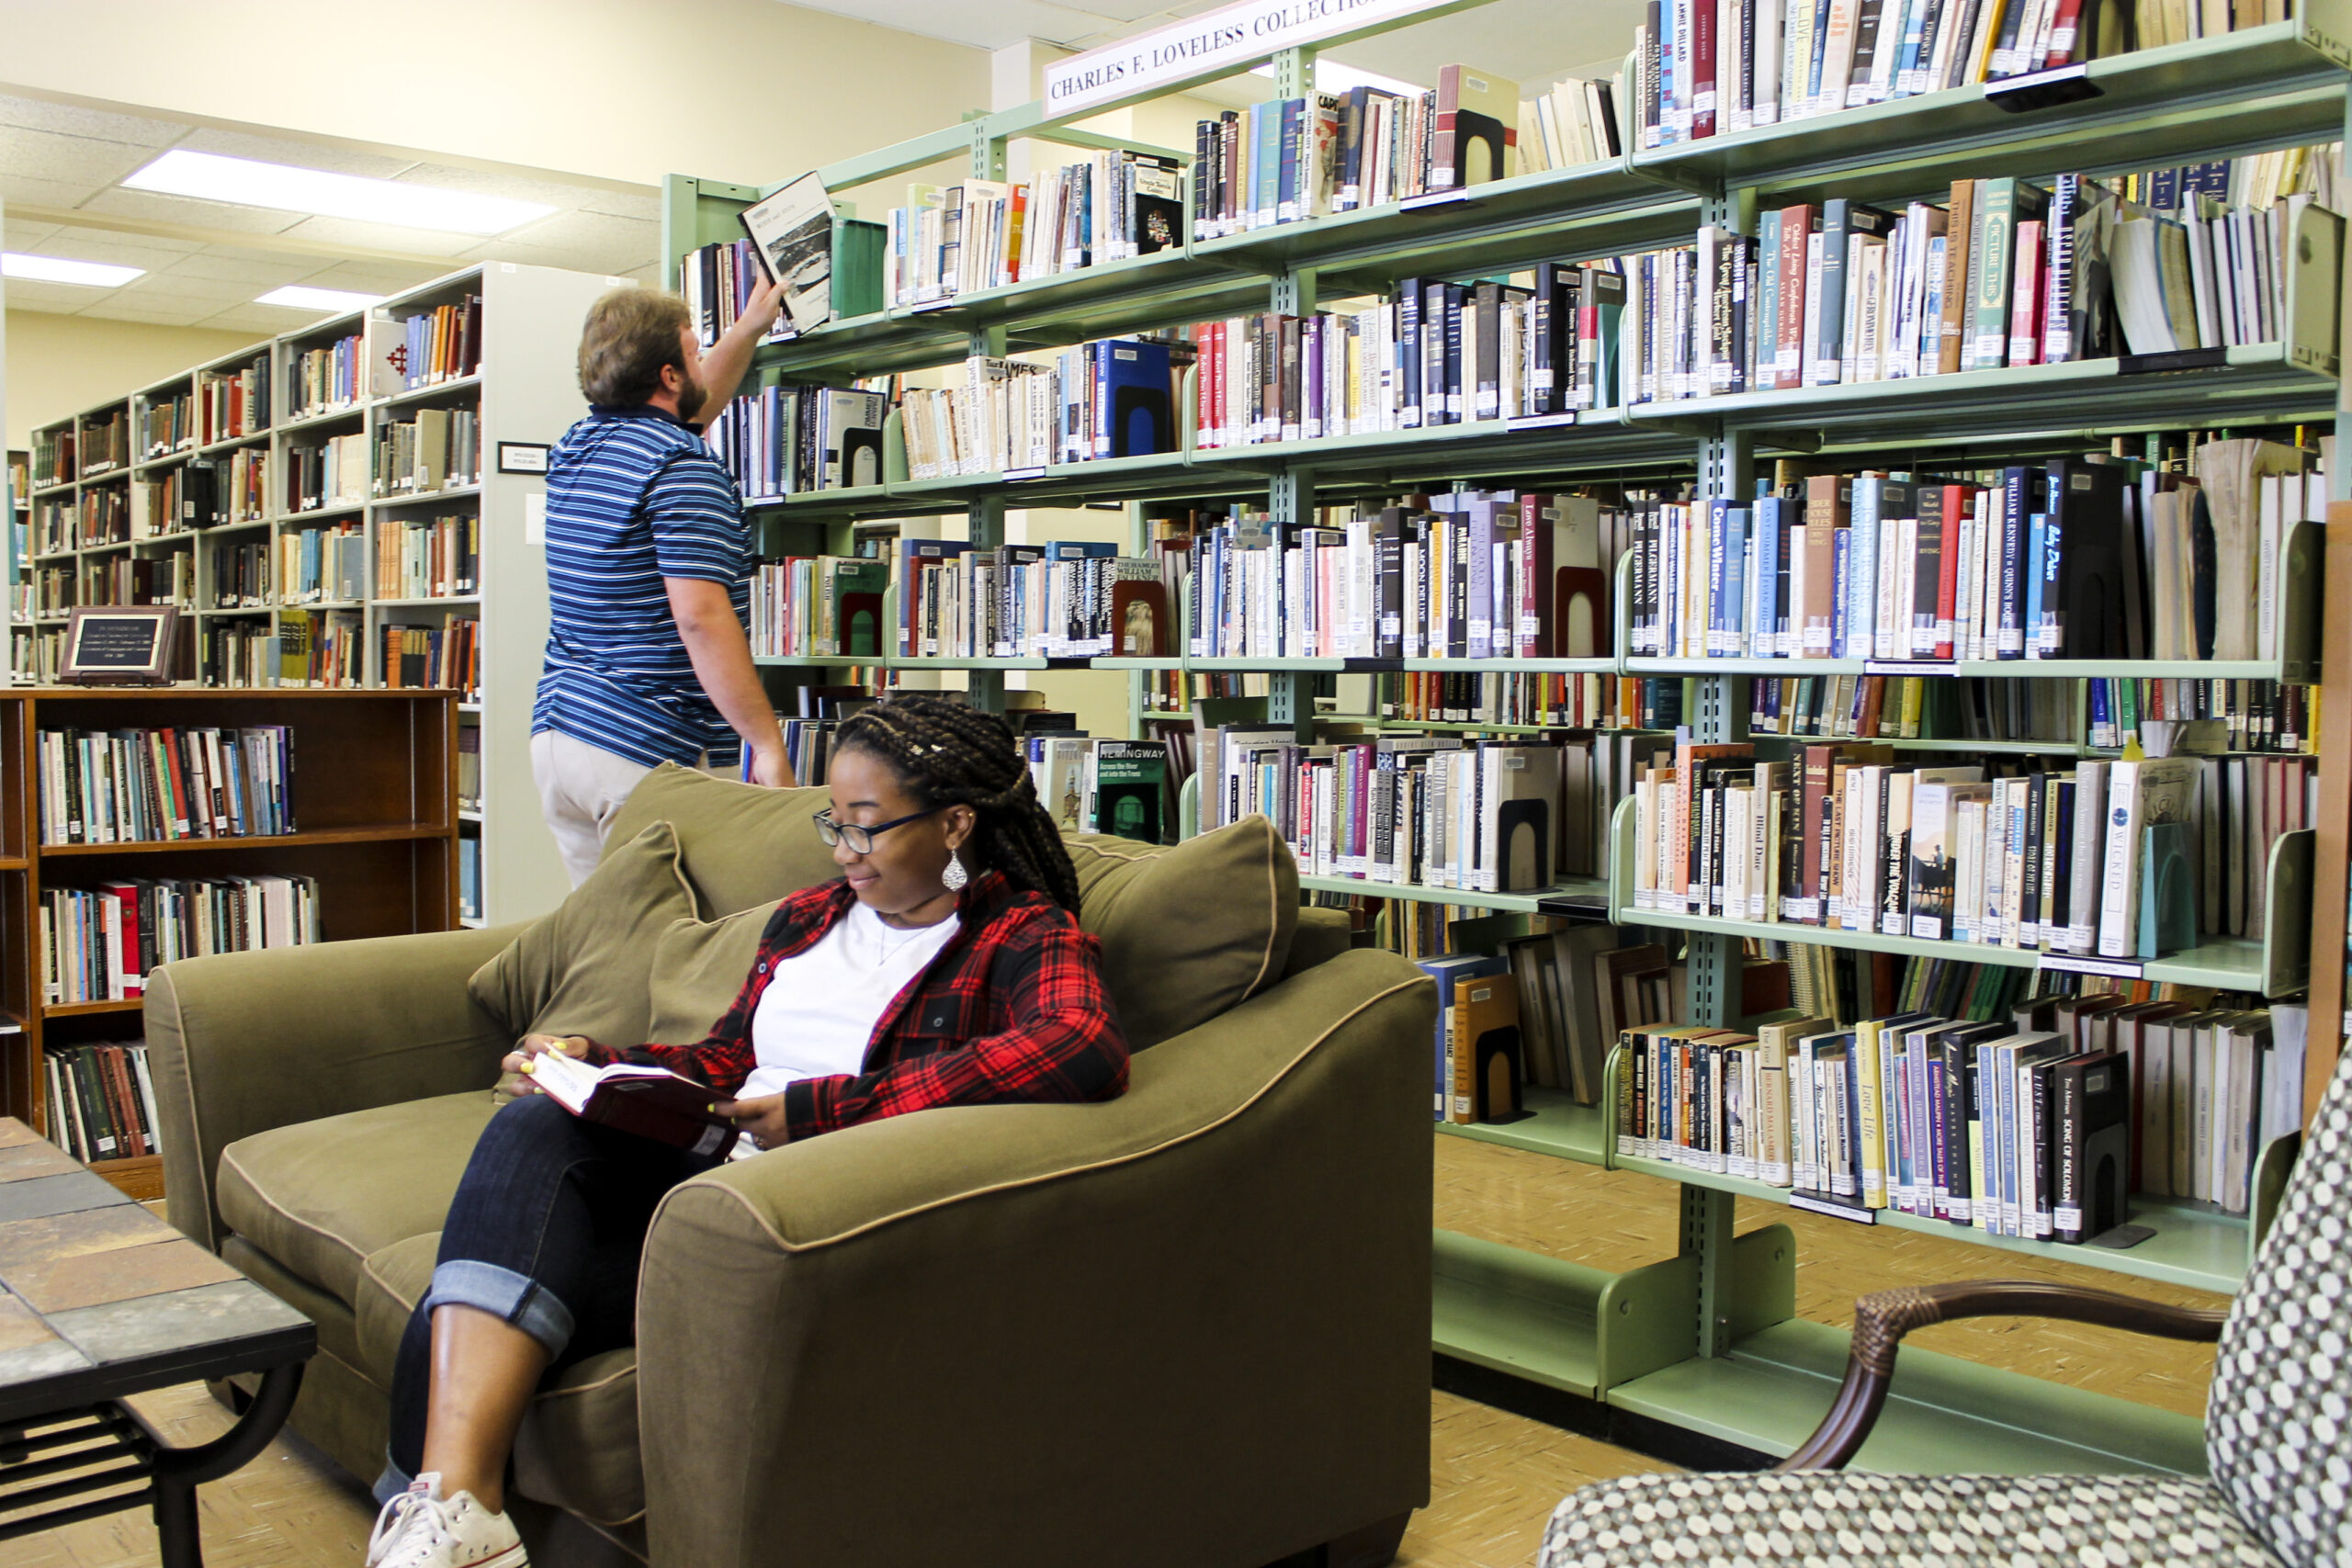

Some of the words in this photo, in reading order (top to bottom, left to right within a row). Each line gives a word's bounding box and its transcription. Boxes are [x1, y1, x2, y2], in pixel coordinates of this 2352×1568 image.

[1678, 3, 1687, 26] ANNIE
[1797, 6, 1812, 42] LOVE
[1678, 29, 1687, 62] DILLARD
[1051, 62, 1124, 100] CHARLES
[1133, 55, 1145, 74] F.
[1153, 24, 1244, 68] LOVELESS
[1951, 200, 1961, 227] THIS
[1782, 226, 1791, 243] Tells
[1792, 223, 1801, 249] Oldest
[1951, 231, 1959, 243] IS
[1972, 214, 1981, 246] ROBERT
[1722, 243, 1733, 261] The
[1782, 245, 1791, 258] All
[1987, 223, 2001, 269] PICTURE
[1766, 251, 1776, 269] The
[1788, 253, 1800, 276] Living
[1719, 262, 1733, 287] Great
[1765, 270, 1775, 287] Old
[1945, 247, 1957, 309] TEACHING
[1987, 272, 1999, 297] THIS
[1713, 288, 1722, 321] Herbert
[1788, 278, 1799, 324] Confederate
[1965, 296, 1975, 330] POETRY
[1567, 308, 1576, 330] Native
[1713, 323, 1722, 341] Gold
[1567, 349, 1576, 374] Richard
[2007, 477, 2018, 515] WILLIAM
[1525, 504, 1534, 526] Love
[1712, 507, 1724, 546] Come
[1851, 497, 1860, 531] PRAYER
[1861, 506, 1874, 551] JOHN
[2006, 518, 2016, 558] KENNEDY
[2044, 525, 2062, 547] Baby
[1456, 527, 1467, 565] PARADISE
[1523, 527, 1534, 560] Always
[1634, 540, 1643, 604] PILGERMANN
[1648, 539, 1658, 604] PILGERMANN
[1711, 546, 1724, 592] Winter
[1850, 556, 1860, 589] OWEN
[1990, 548, 1999, 604] IRONWEED
[2045, 548, 2060, 581] Driver
[1762, 580, 1770, 603] EVAN
[1860, 557, 1873, 608] IRVING
[2005, 568, 2015, 600] QUINN'S
[2003, 602, 2012, 624] BOOK
[1116, 762, 1125, 771] the
[1127, 770, 1141, 778] Trees
[1434, 755, 1446, 796] SPARTINA
[1792, 753, 1802, 786] NEXT
[1792, 788, 1801, 805] OF
[1835, 789, 1843, 804] THE
[2080, 771, 2091, 805] Victory
[1660, 799, 1666, 809] ON
[1755, 815, 1764, 843] Blind
[1792, 808, 1801, 831] KIN
[2078, 807, 2087, 838] Among
[1834, 829, 1842, 861] PICTURE
[2027, 845, 2037, 863] STORY
[2078, 841, 2087, 855] the
[1754, 847, 1764, 871] Date
[1889, 862, 1902, 876] THE
[2110, 831, 2124, 890] WICKED
[1832, 863, 1840, 886] SHOW
[1765, 1073, 1774, 1112] BERNARD
[1933, 1066, 1941, 1098] ARMISTEAD
[2034, 1076, 2042, 1104] LUST
[1861, 1085, 1874, 1111] Love
[1934, 1099, 1942, 1122] MAUPIN
[1766, 1115, 1776, 1161] MALAMUD
[1863, 1117, 1875, 1139] Life
[2063, 1119, 2072, 1143] SONG
[2064, 1145, 2072, 1156] OF
[1937, 1164, 1944, 1172] OF
[2062, 1158, 2071, 1202] SOLOMON
